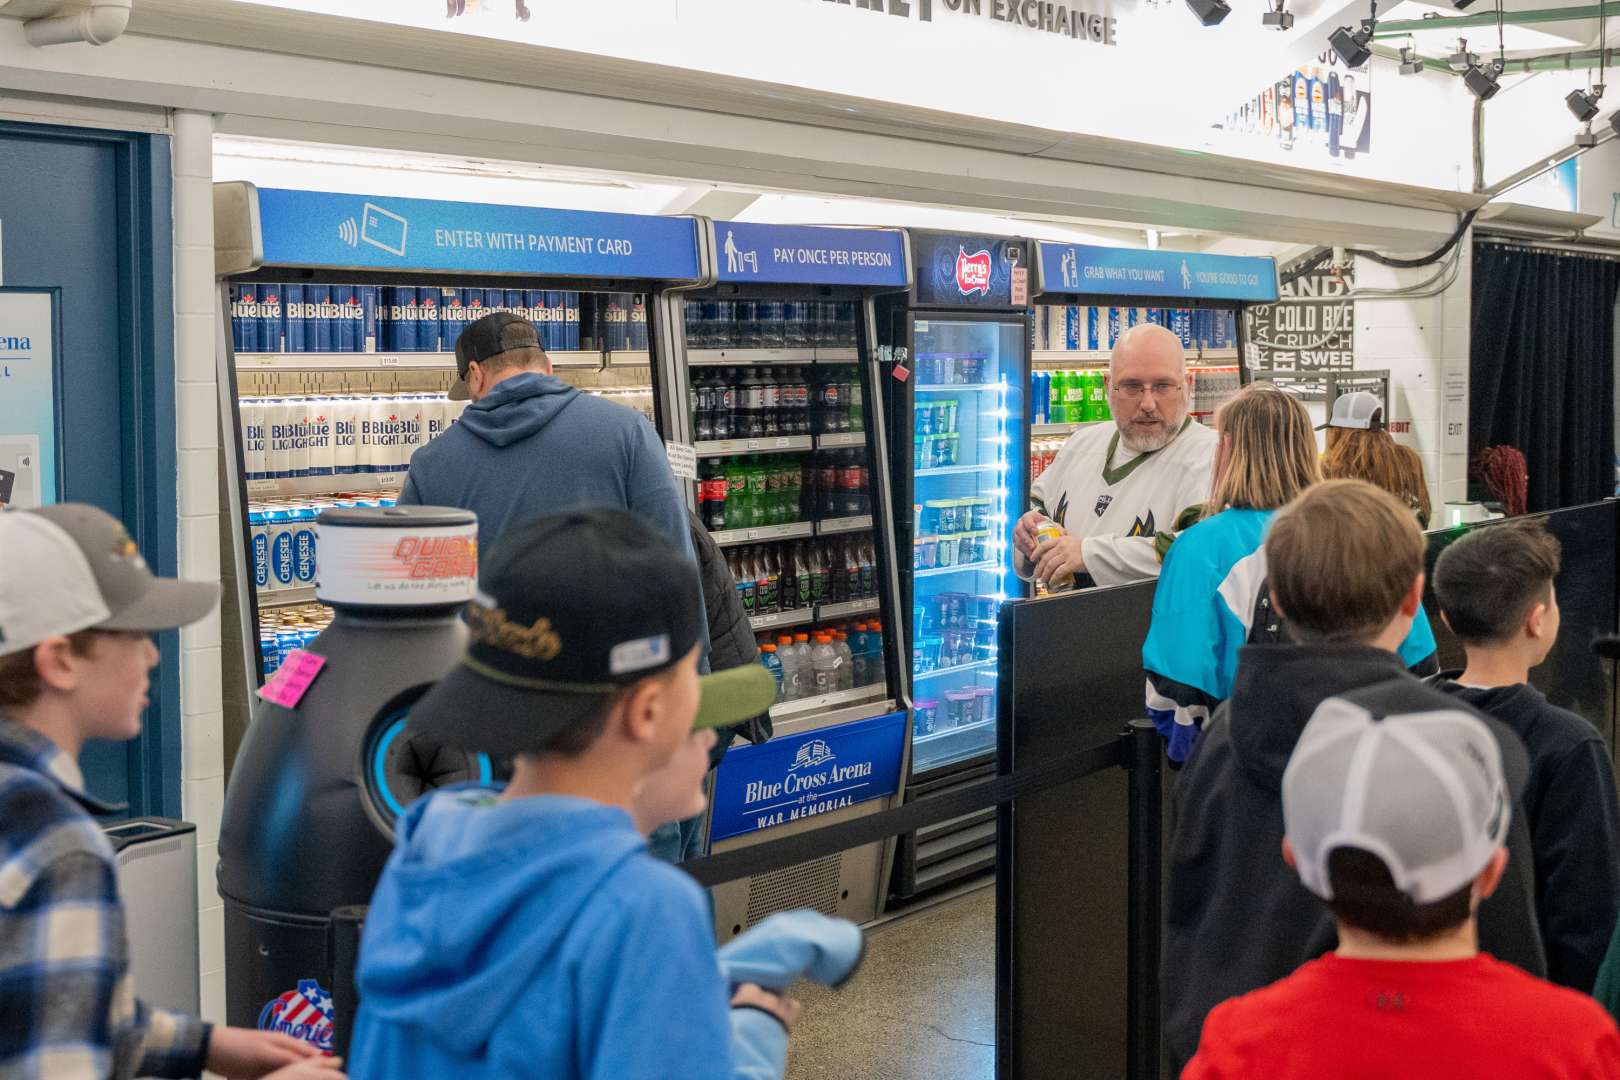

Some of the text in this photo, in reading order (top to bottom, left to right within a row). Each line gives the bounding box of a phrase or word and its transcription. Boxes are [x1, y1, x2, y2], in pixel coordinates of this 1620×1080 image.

[990, 0, 1117, 46] EXCHANGE
[435, 229, 633, 256] ENTER WITH PAYMENT CARD
[773, 247, 892, 267] PAY ONCE PER PERSON
[961, 257, 988, 280] Perry's
[1083, 265, 1165, 282] GRAB WHAT YOU WANT
[1219, 273, 1238, 286] GOOD
[1239, 274, 1247, 286] TO
[329, 303, 363, 319] Blue
[1275, 305, 1317, 331] COLD
[372, 420, 400, 435] Blue
[1388, 421, 1411, 434] EDIT
[1448, 423, 1463, 436] EXIT
[372, 434, 400, 446] LIGHT
[256, 536, 266, 584] GENESEE
[279, 535, 291, 582] GENESEE
[298, 533, 310, 579] GENESEE
[816, 672, 826, 685] G
[744, 761, 872, 804] Blue Cross Arena
[798, 792, 819, 804] at the
[757, 794, 853, 829] WAR MEMORIAL
